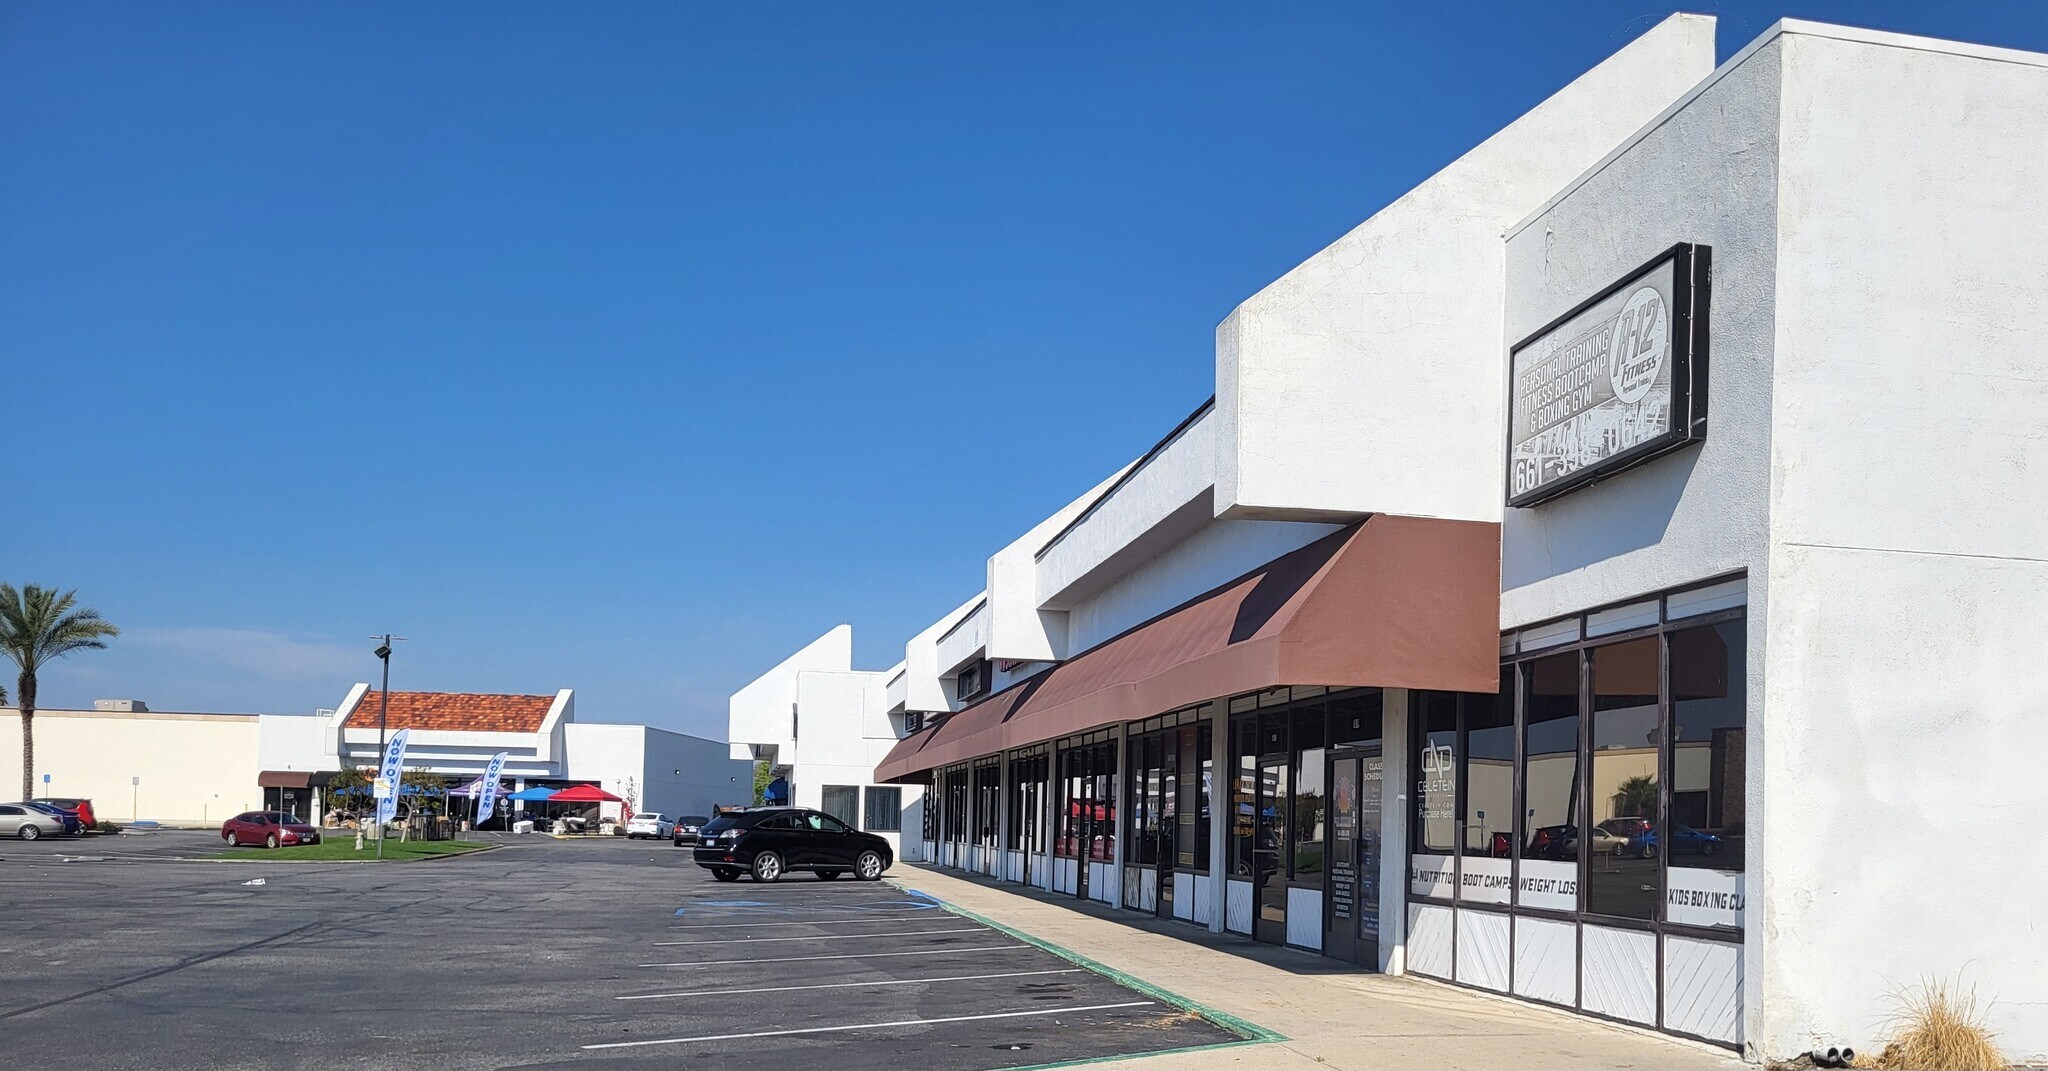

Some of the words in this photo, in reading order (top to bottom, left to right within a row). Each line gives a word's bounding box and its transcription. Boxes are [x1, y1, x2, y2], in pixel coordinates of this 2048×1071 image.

[1520, 355, 1562, 396] PERSONAL
[1565, 329, 1609, 371] TRAINING
[1520, 383, 1553, 417] FITNESS
[1555, 353, 1607, 399] BOOTCAMP
[1530, 413, 1536, 433] &
[1538, 395, 1570, 429] BOXING
[1572, 383, 1592, 412] GYM
[388, 738, 402, 764] NOW
[489, 759, 500, 779] NOW
[483, 781, 494, 808] OPEN
[1418, 869, 1455, 885] NUTRITIO
[1462, 873, 1483, 886] BOOT
[1520, 877, 1556, 894] WEIGHT
[1558, 881, 1578, 896] LOS
[1668, 888, 1690, 906] KIDS
[1690, 890, 1728, 910] BOXING
